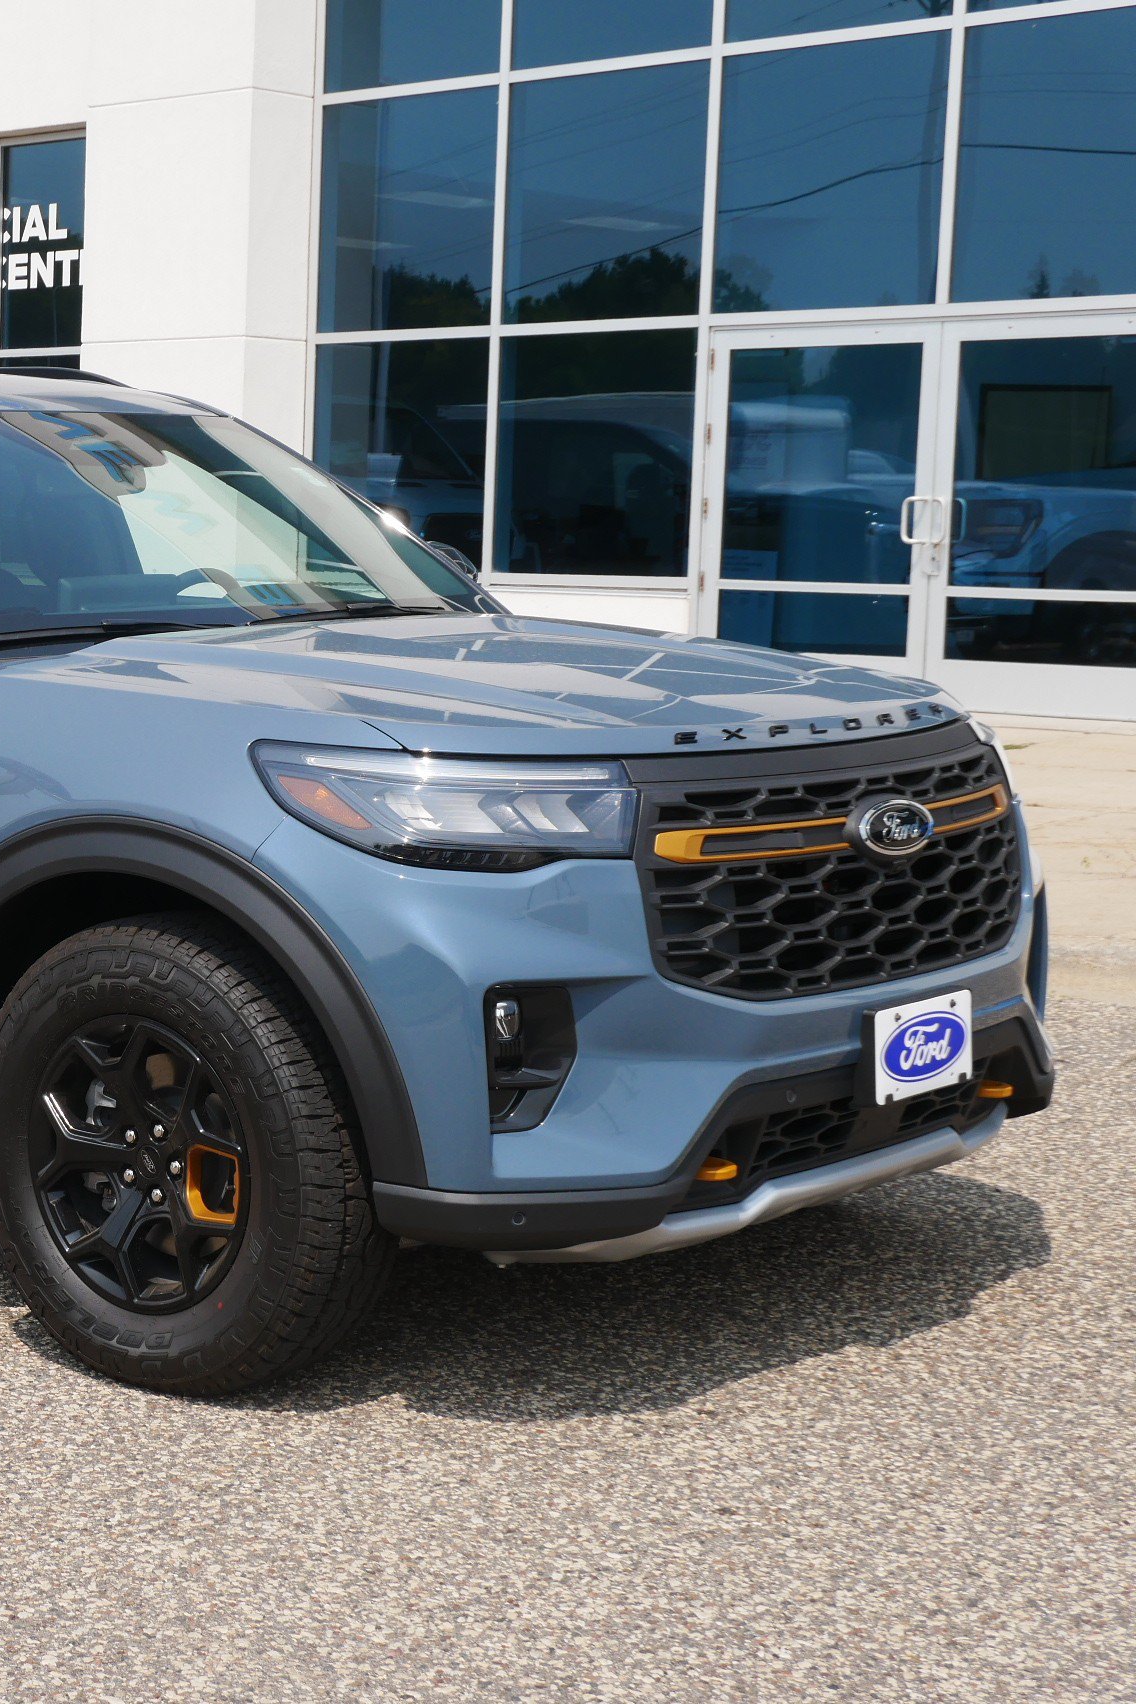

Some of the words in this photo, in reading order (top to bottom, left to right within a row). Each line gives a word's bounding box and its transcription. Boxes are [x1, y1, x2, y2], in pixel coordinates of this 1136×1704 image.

[673, 702, 946, 746] EXPLORER
[882, 811, 922, 843] Ford
[899, 1022, 953, 1071] Ford
